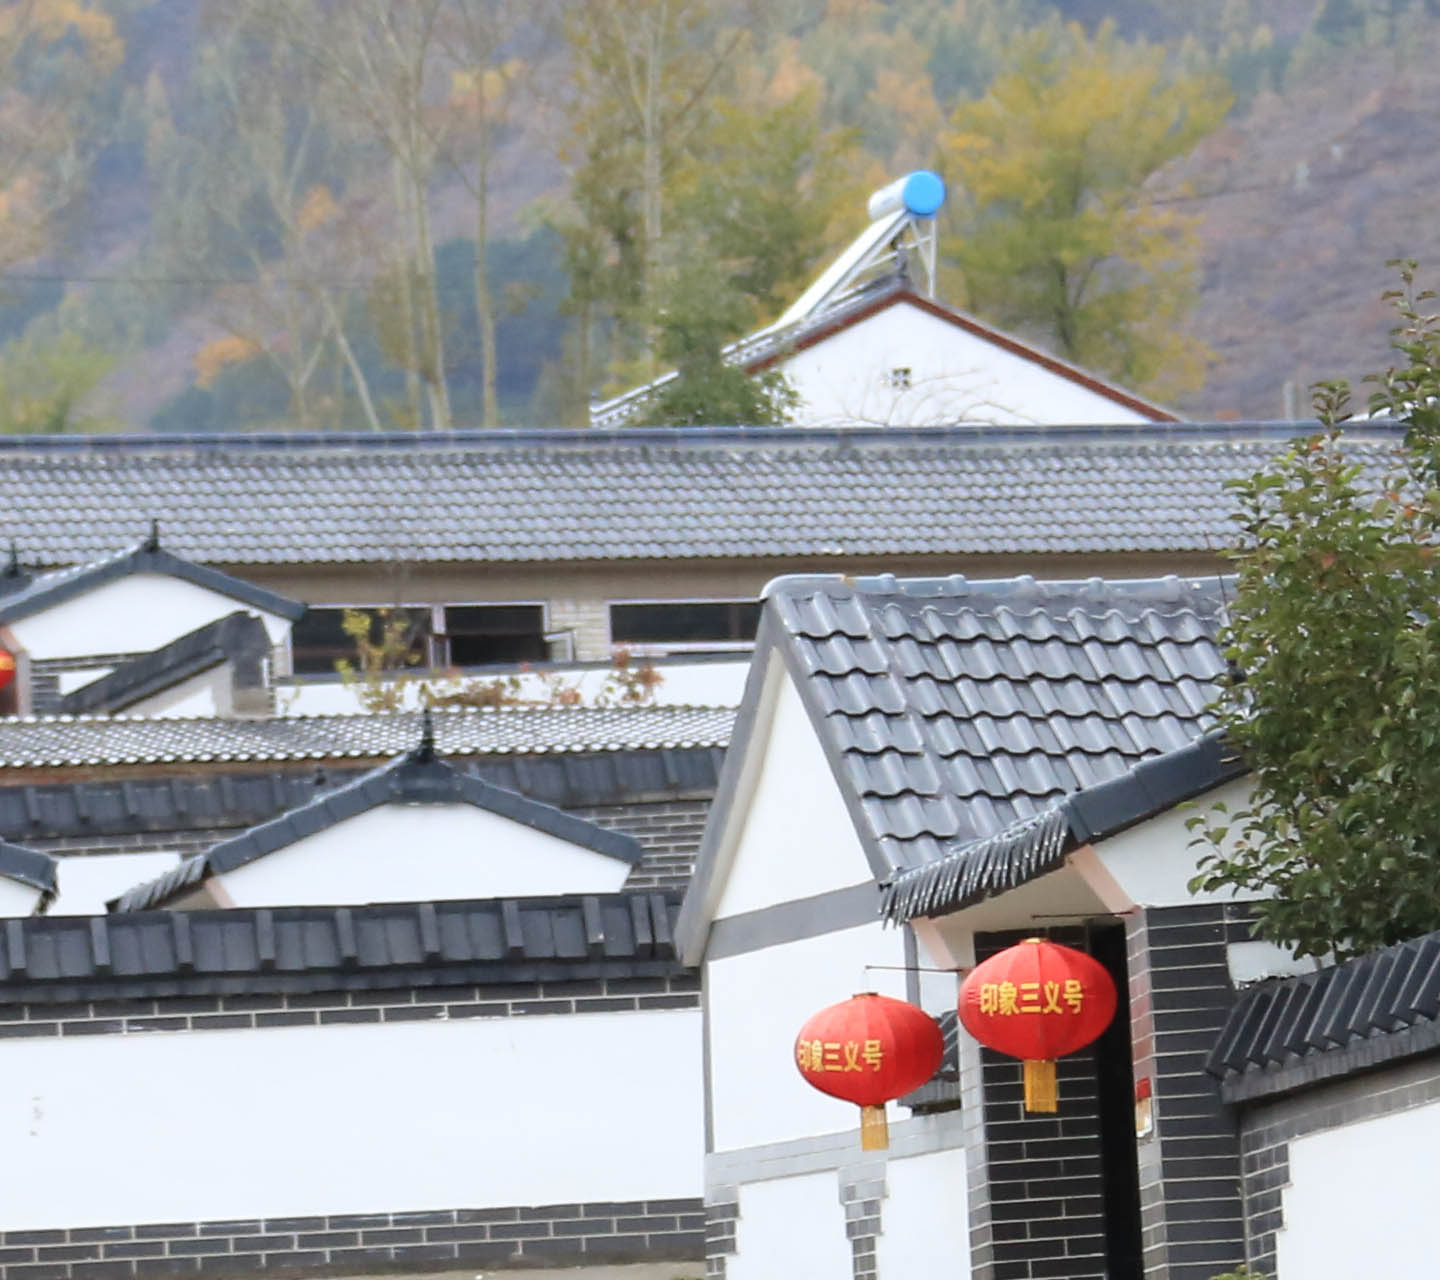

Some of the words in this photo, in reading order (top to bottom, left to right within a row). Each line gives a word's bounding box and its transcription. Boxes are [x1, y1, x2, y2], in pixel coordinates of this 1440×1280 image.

[980, 979, 1084, 1017] 印象三义号
